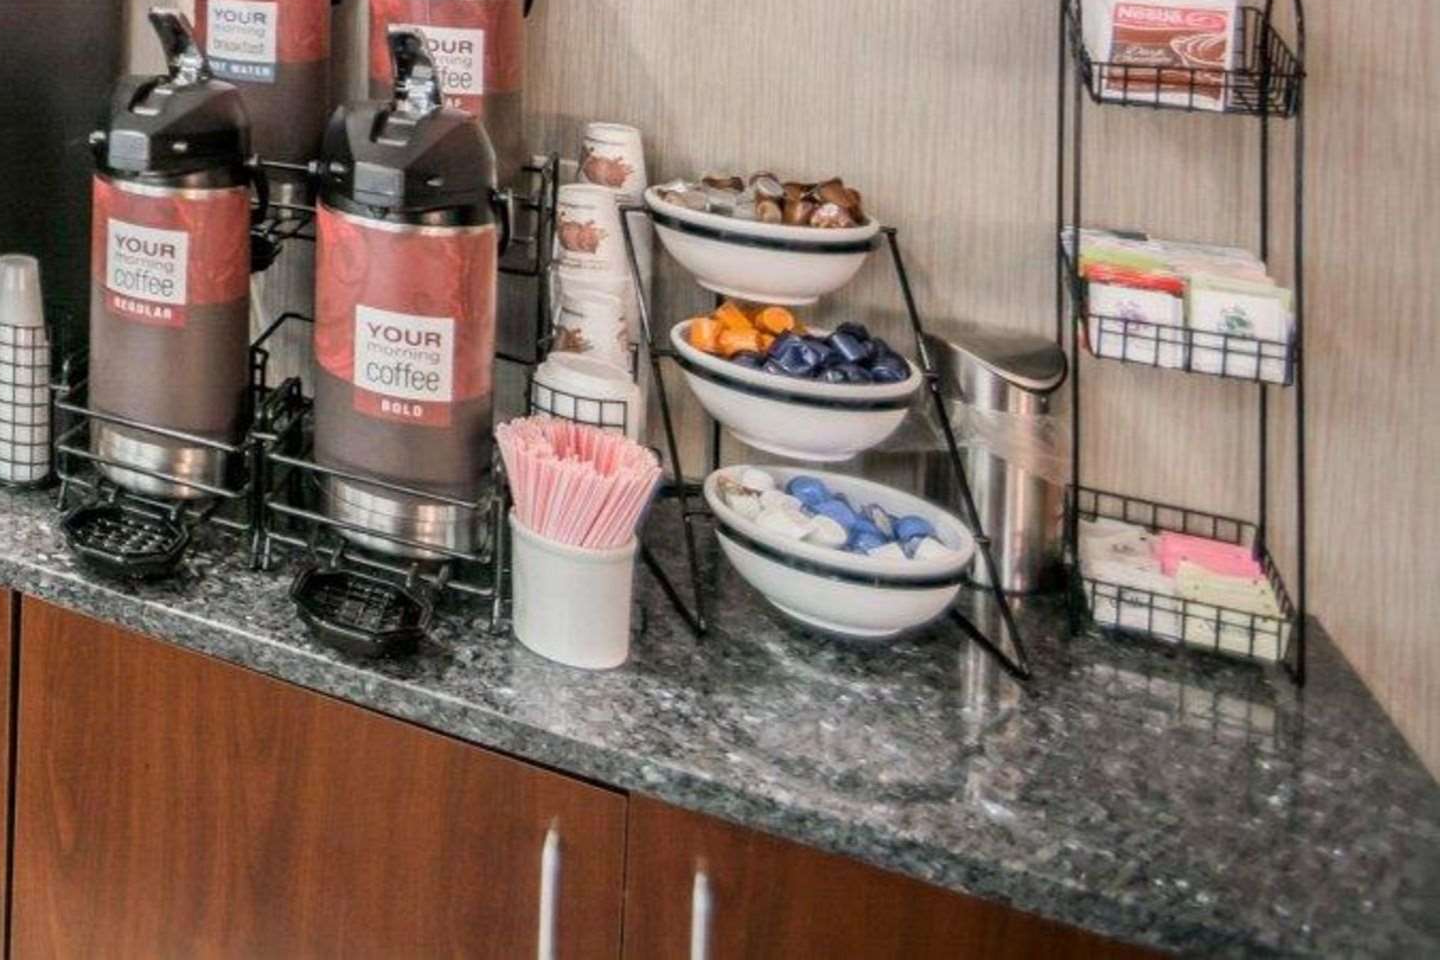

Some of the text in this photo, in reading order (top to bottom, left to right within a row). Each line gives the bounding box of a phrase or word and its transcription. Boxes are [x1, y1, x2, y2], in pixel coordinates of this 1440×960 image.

[213, 8, 267, 25] YOUR
[425, 38, 473, 54] OUR
[115, 234, 176, 259] YOUR
[114, 268, 175, 298] coffee
[113, 296, 173, 320] REGULAR
[367, 322, 442, 348] YOUR
[367, 342, 441, 365] morning
[366, 361, 440, 392] coffee
[381, 399, 423, 418] BOLD
